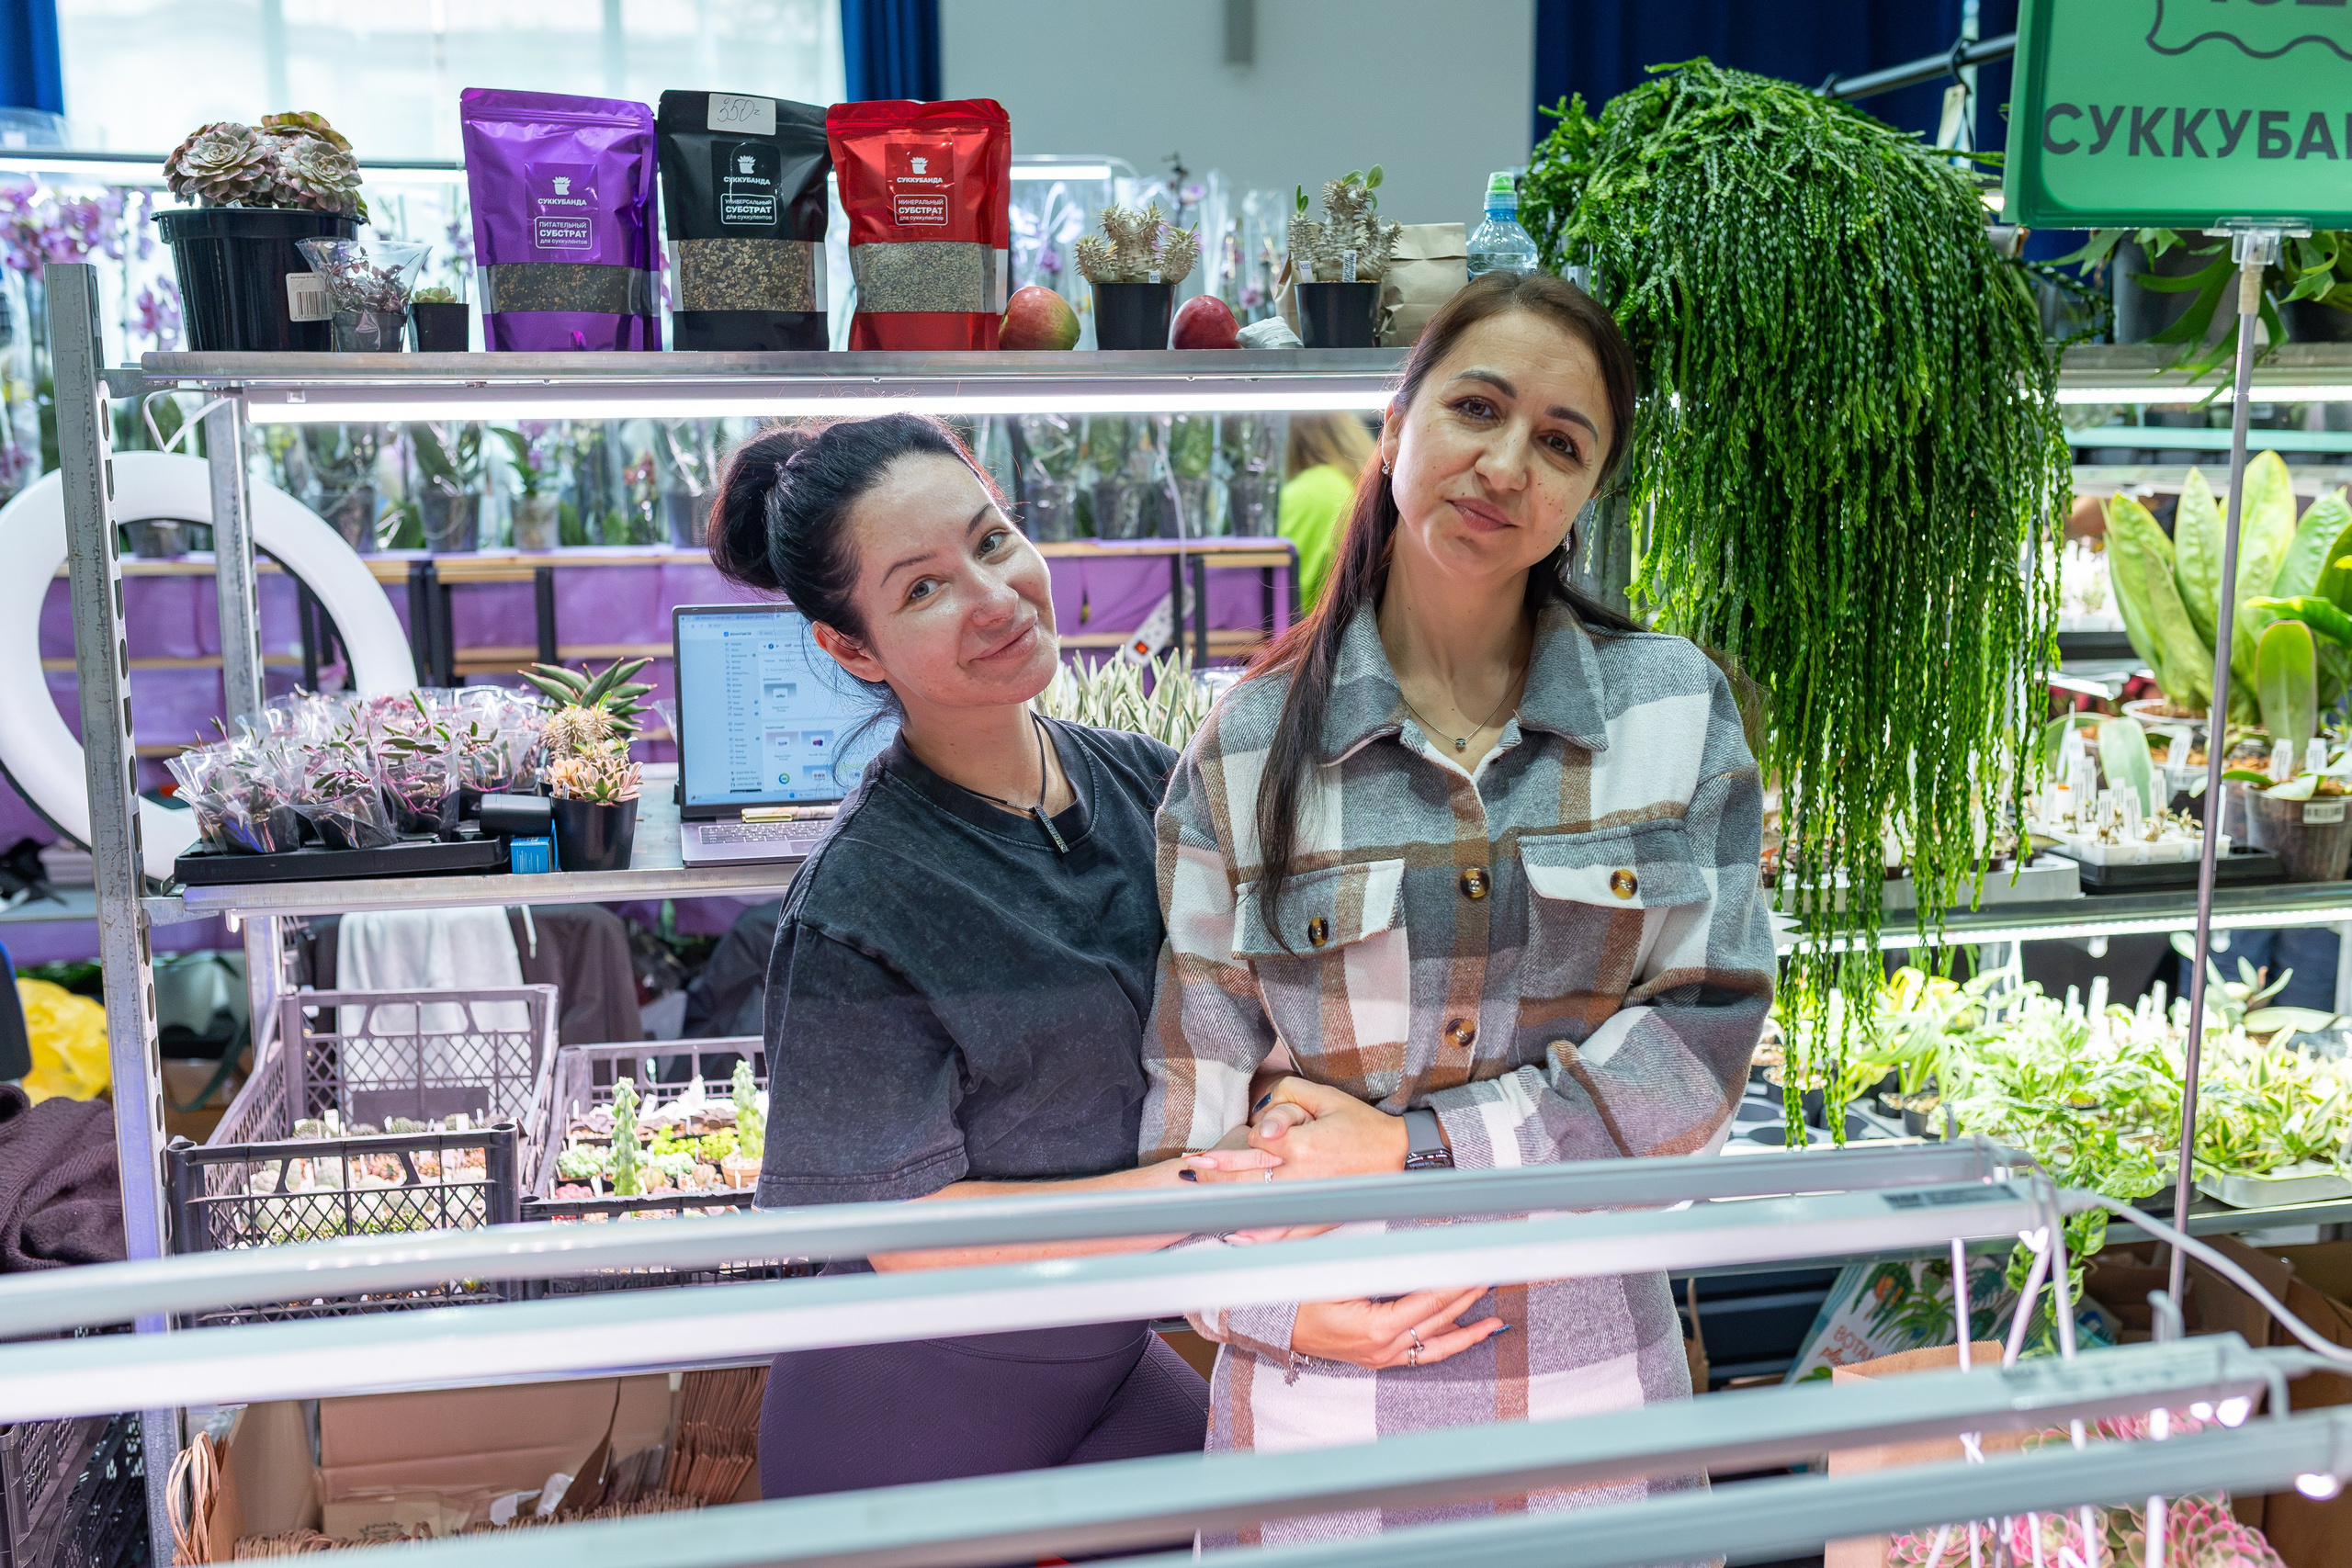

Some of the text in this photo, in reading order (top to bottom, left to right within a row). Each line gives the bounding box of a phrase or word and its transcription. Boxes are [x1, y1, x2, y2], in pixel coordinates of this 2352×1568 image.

[723, 176, 771, 186] СУККУБАНДА
[537, 197, 587, 206] СУККУБАНДА
[725, 206, 773, 214] СУБСТРАТ
[539, 229, 587, 238] СУБСТРАТ
